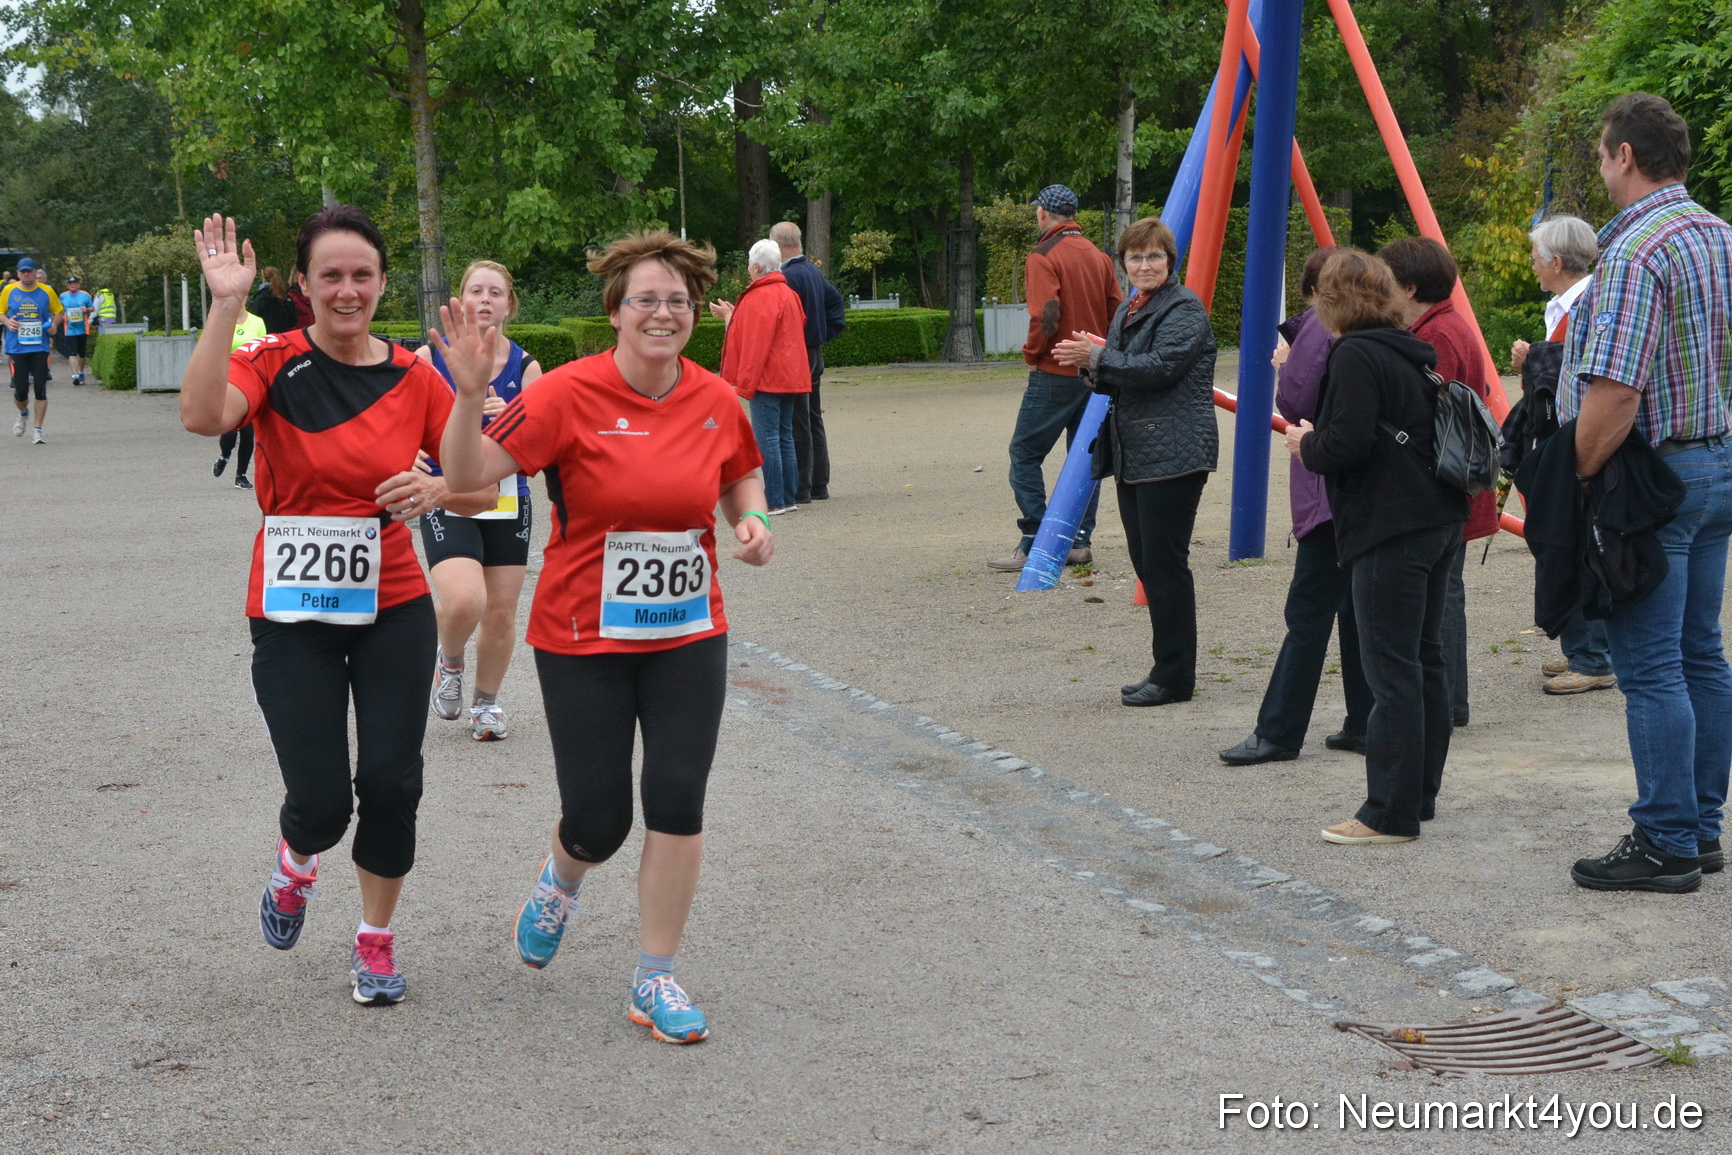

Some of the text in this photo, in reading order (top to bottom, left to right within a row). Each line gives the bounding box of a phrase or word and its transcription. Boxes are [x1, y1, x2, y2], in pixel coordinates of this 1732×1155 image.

[20, 327, 41, 336] 2246
[267, 527, 361, 538] PARTL Neumarkt
[608, 541, 649, 552] PARTL
[276, 542, 370, 583] 2266
[616, 554, 704, 598] 2363
[301, 592, 340, 608] Petra
[635, 608, 686, 624] Monika
